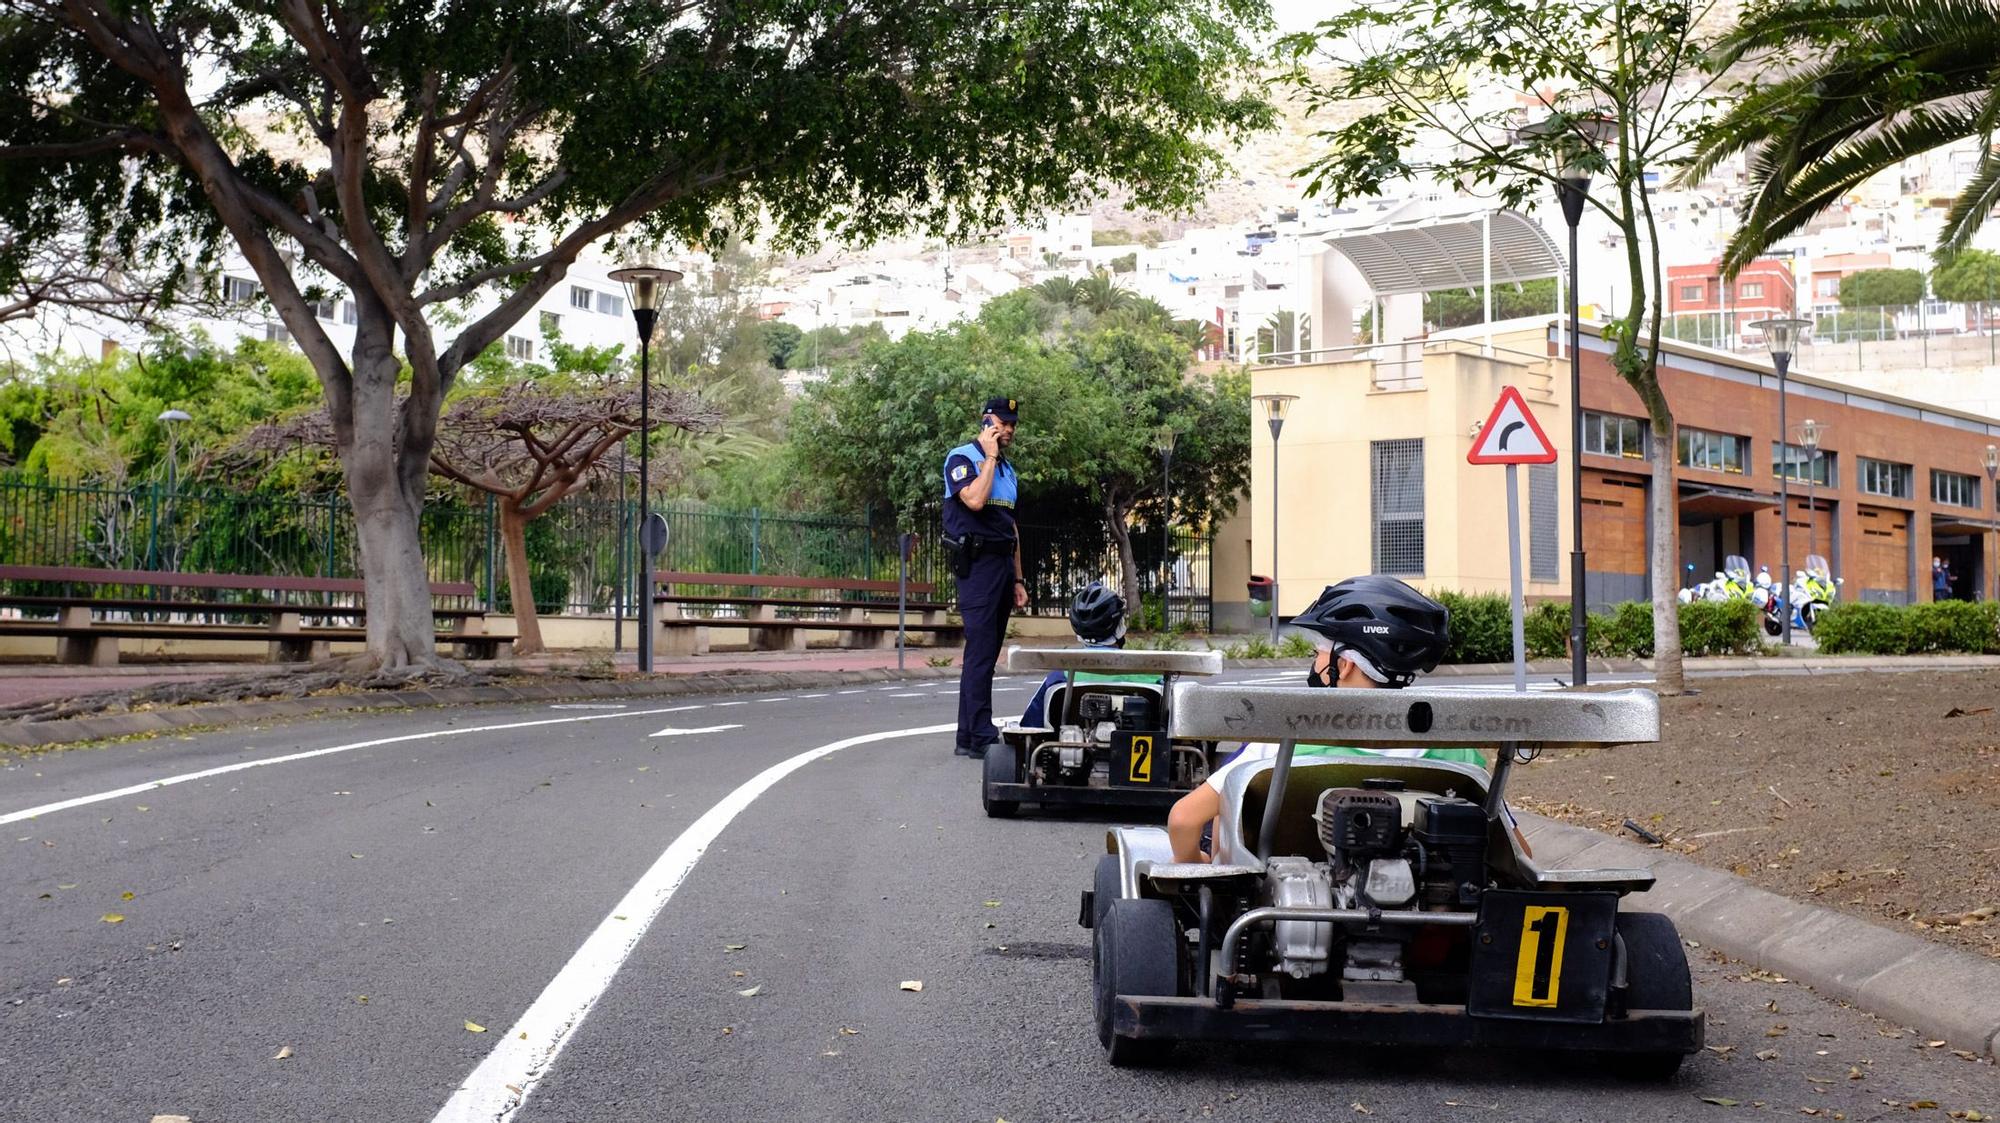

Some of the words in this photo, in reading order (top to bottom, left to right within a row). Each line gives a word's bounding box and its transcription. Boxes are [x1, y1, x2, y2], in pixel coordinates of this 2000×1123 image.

[1362, 625, 1390, 635] uvex
[1132, 738, 1150, 779] 2
[1528, 911, 1561, 1001] 1
